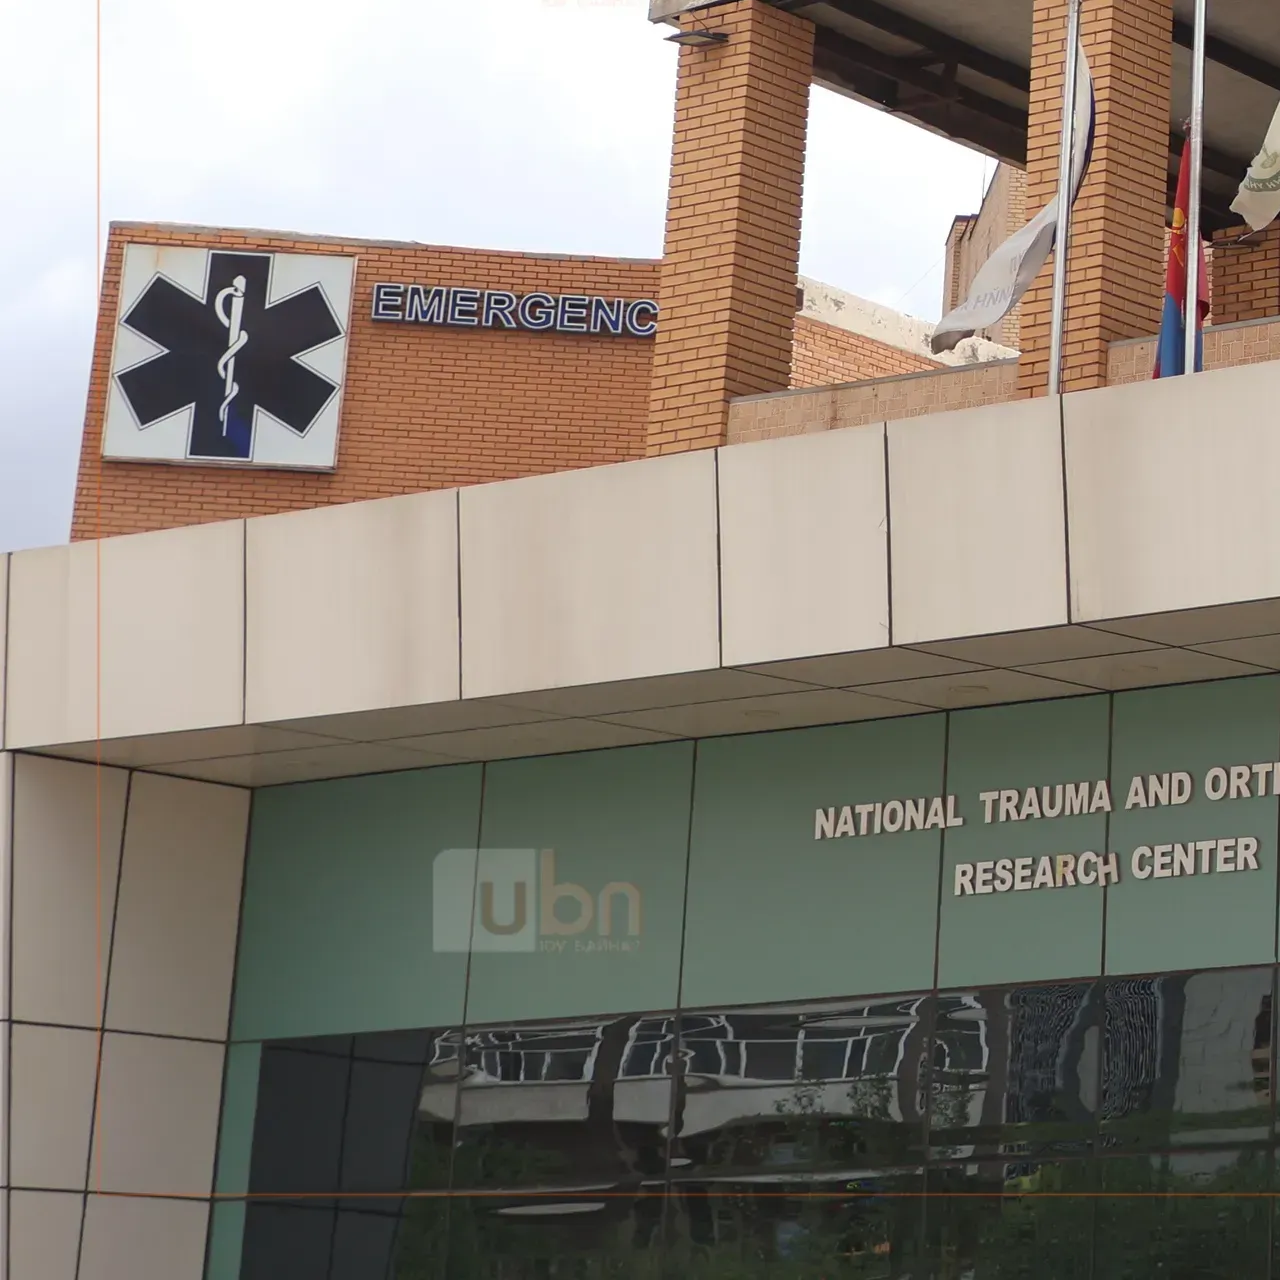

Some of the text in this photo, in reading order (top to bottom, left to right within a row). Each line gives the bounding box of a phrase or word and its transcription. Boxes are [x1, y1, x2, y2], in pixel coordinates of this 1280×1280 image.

[370, 281, 659, 337] EMERGENC
[813, 795, 964, 839] NATIONAL
[979, 778, 1113, 824] TRAUMA
[1125, 771, 1192, 811] AND
[953, 836, 1260, 897] RESEARCH CENTER
